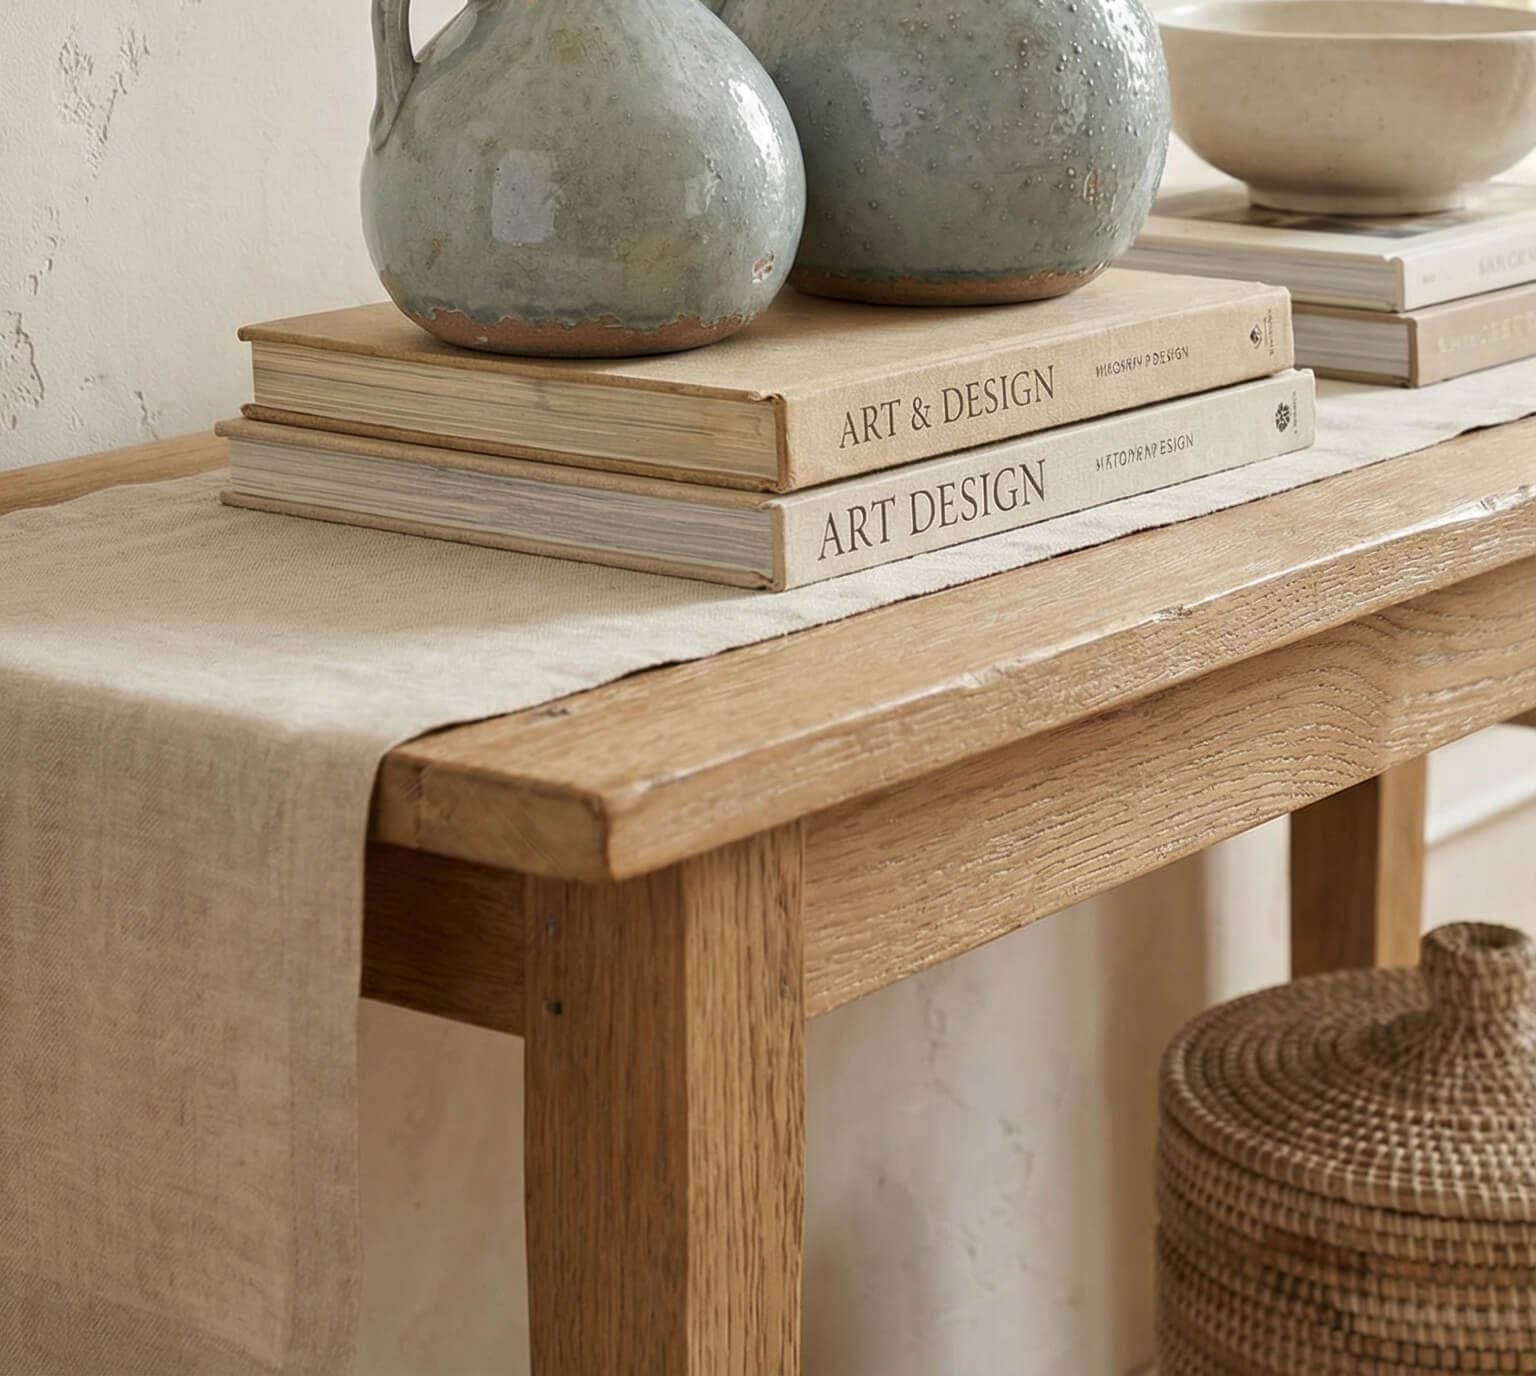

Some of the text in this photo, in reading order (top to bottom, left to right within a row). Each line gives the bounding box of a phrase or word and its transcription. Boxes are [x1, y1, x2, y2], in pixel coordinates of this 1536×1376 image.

[839, 398, 901, 449] ART
[911, 396, 932, 431] &
[941, 365, 1055, 424] DESIGN
[817, 459, 1046, 561] ART DESIGN
